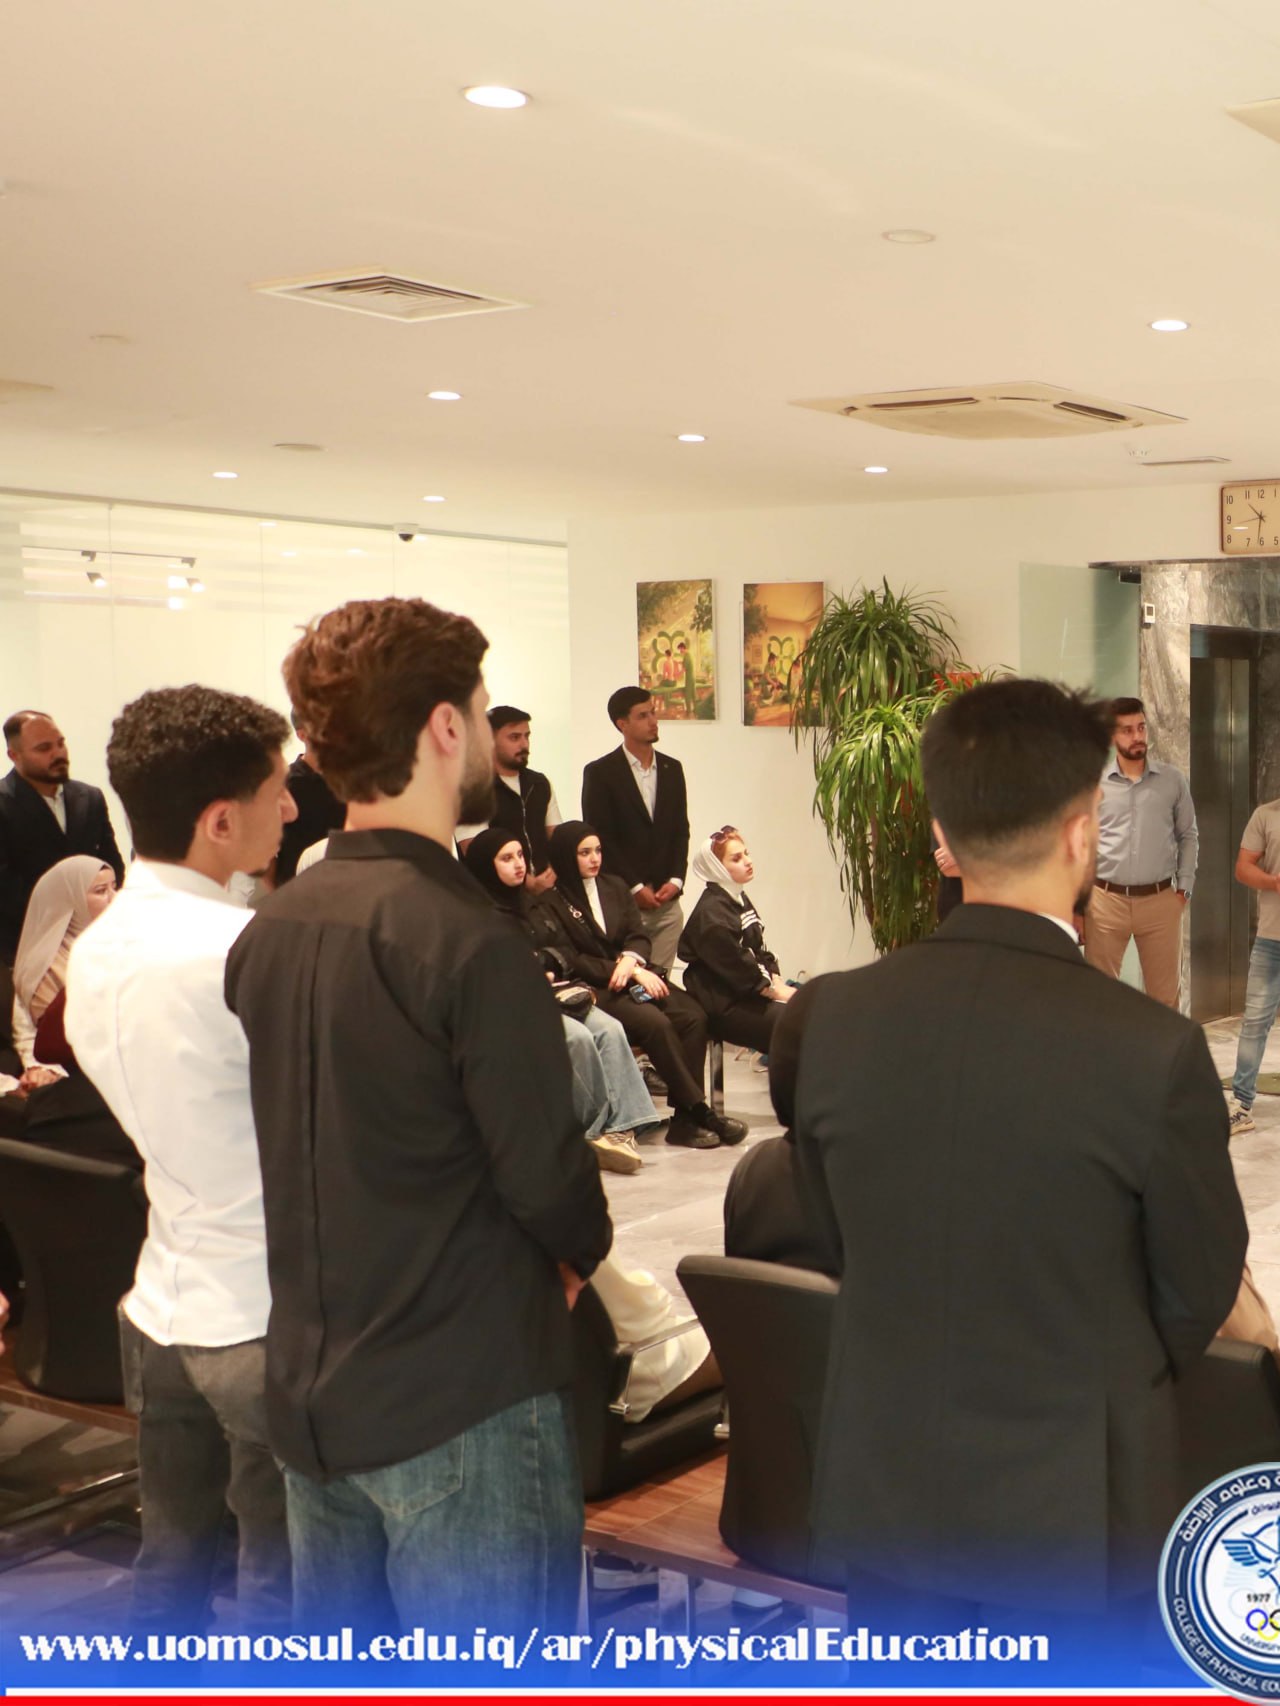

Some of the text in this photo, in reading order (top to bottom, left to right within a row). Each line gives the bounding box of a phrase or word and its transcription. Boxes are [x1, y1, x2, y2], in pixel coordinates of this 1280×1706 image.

[1244, 489, 1251, 500] 11
[1257, 488, 1265, 499] 12
[1273, 488, 1277, 499] 1
[1226, 495, 1234, 505] 10
[1226, 515, 1232, 525] 9
[1226, 534, 1232, 544] 8
[1246, 537, 1251, 547] 7
[1259, 537, 1265, 546] 6
[1273, 536, 1279, 546] 5
